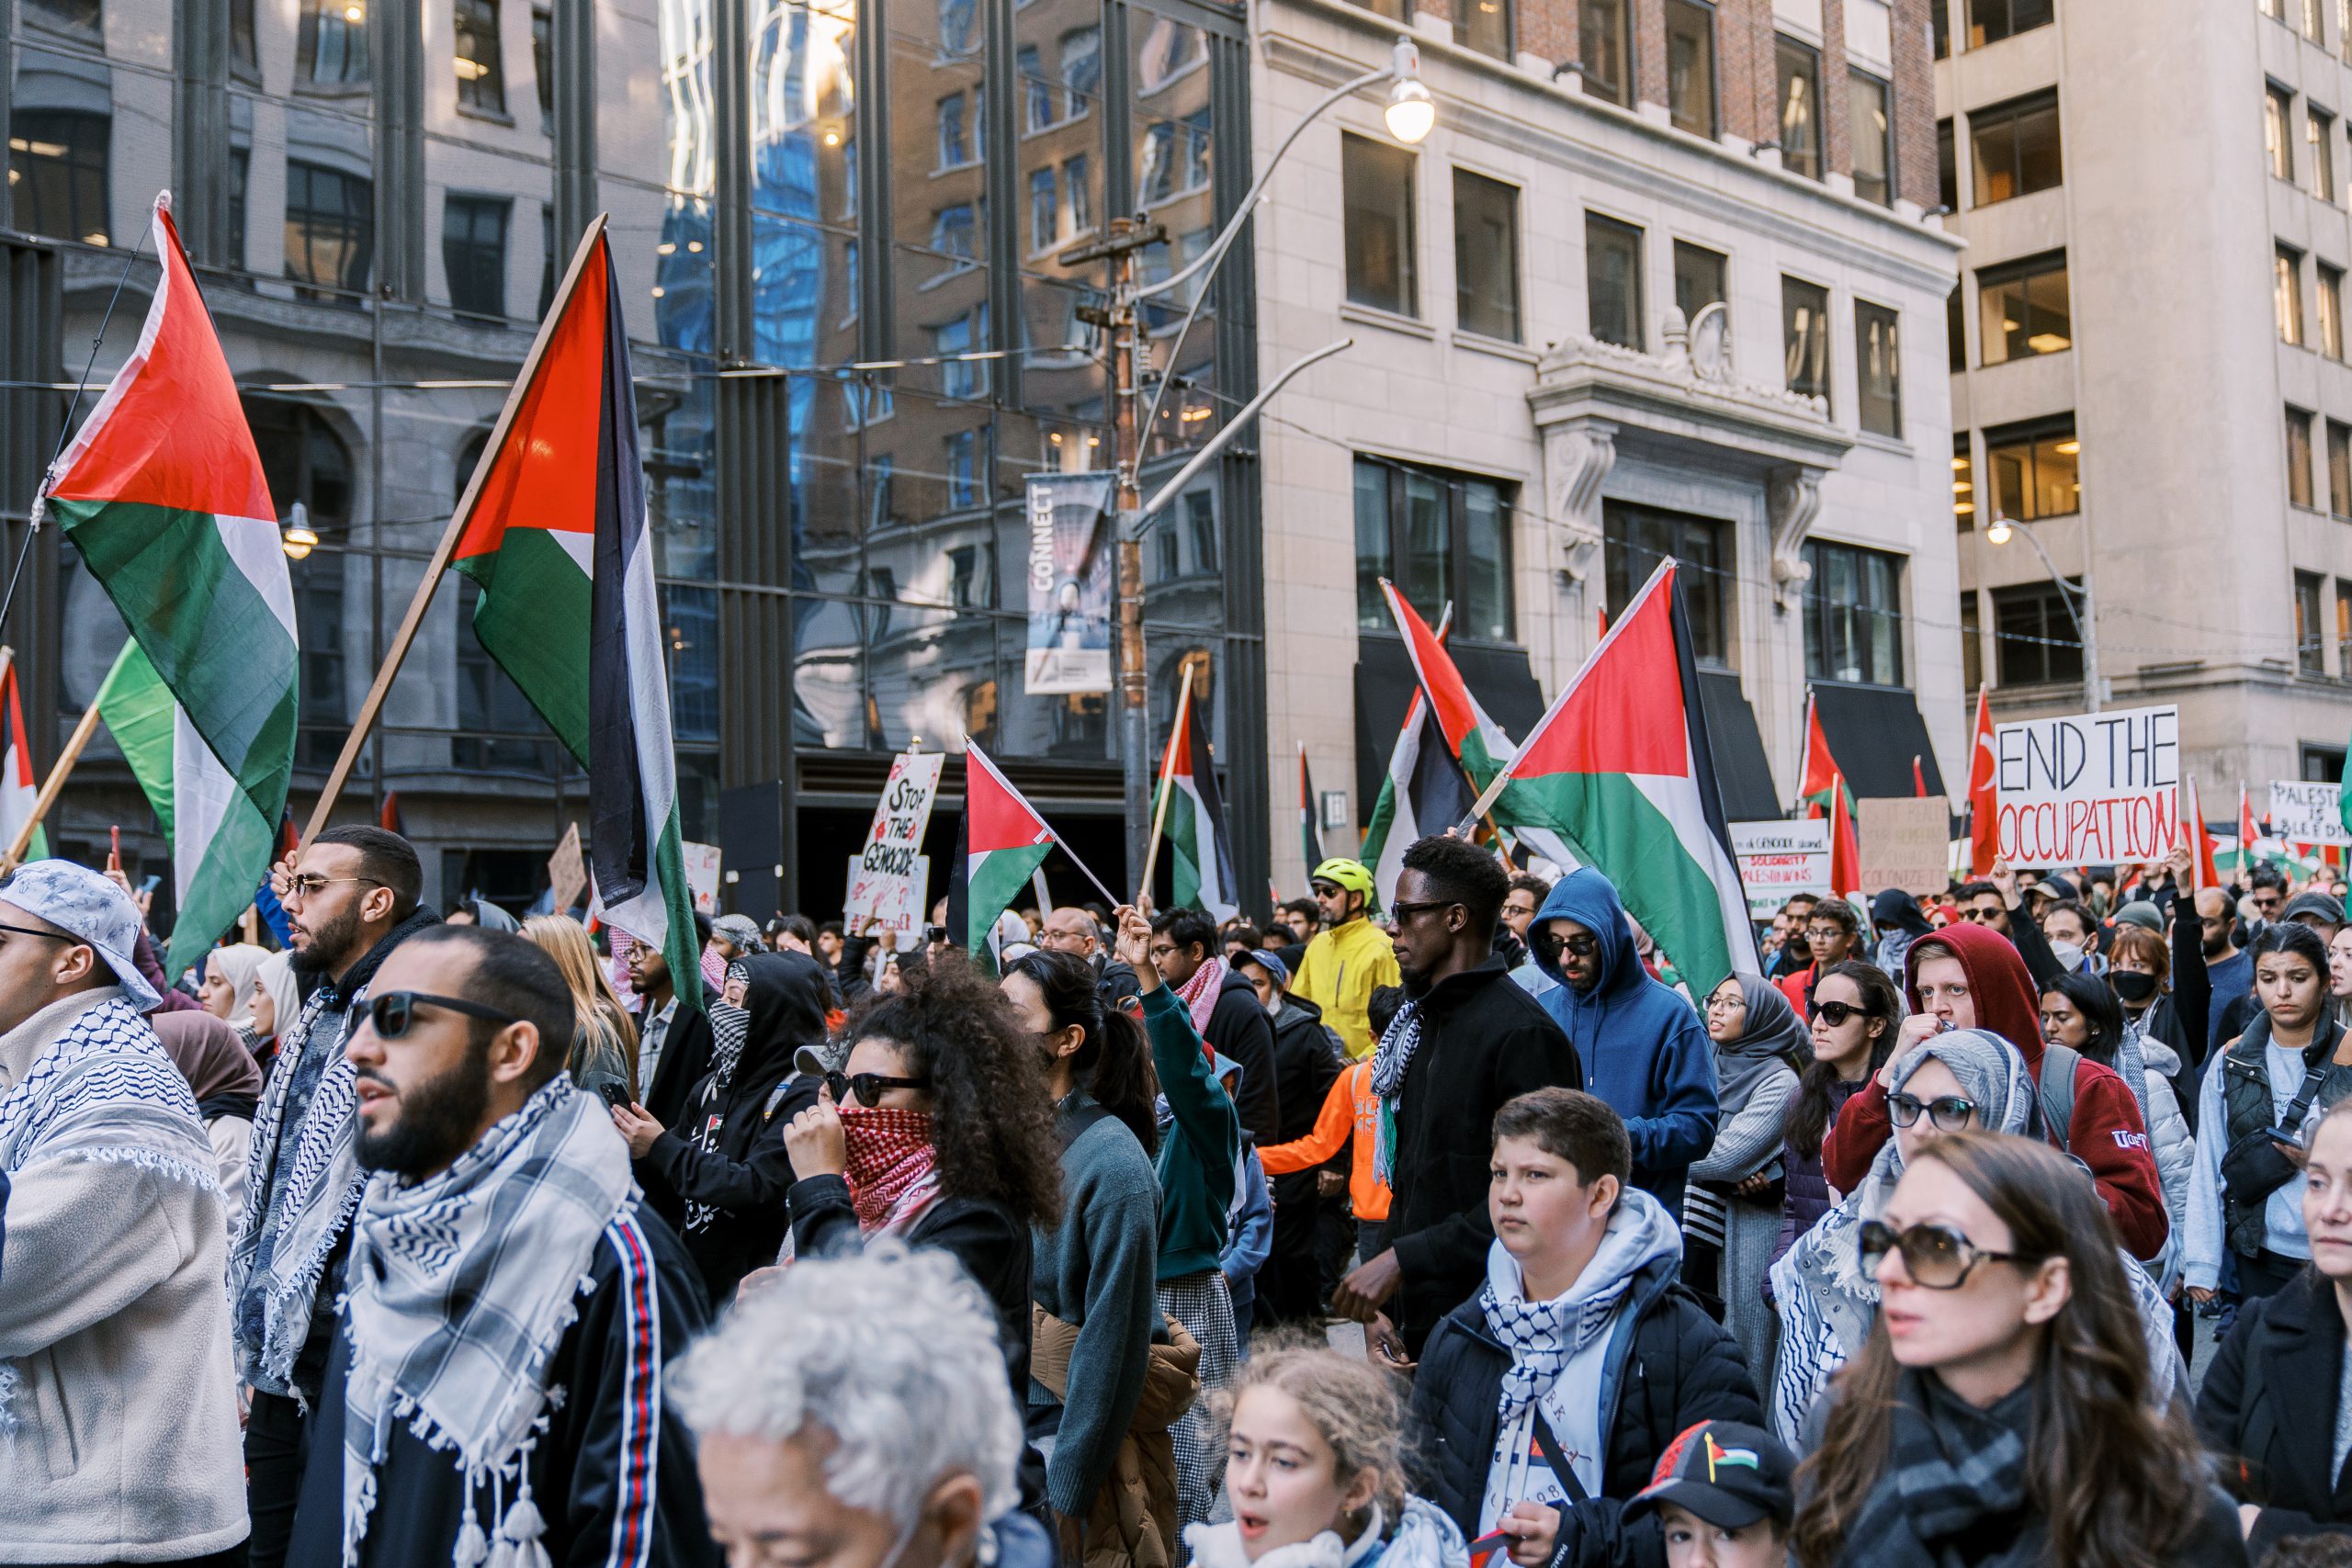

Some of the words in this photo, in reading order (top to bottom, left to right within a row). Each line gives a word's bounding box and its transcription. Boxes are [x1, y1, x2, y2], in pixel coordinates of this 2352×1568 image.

[1031, 483, 1054, 592] CONNECT
[1999, 721, 2086, 792] END
[2095, 712, 2177, 789] THE
[888, 778, 926, 812] STOP
[888, 818, 914, 840] THE
[1998, 787, 2177, 863] OCCUPATION
[2310, 808, 2324, 823] IS
[864, 842, 917, 877] GENOCIDE
